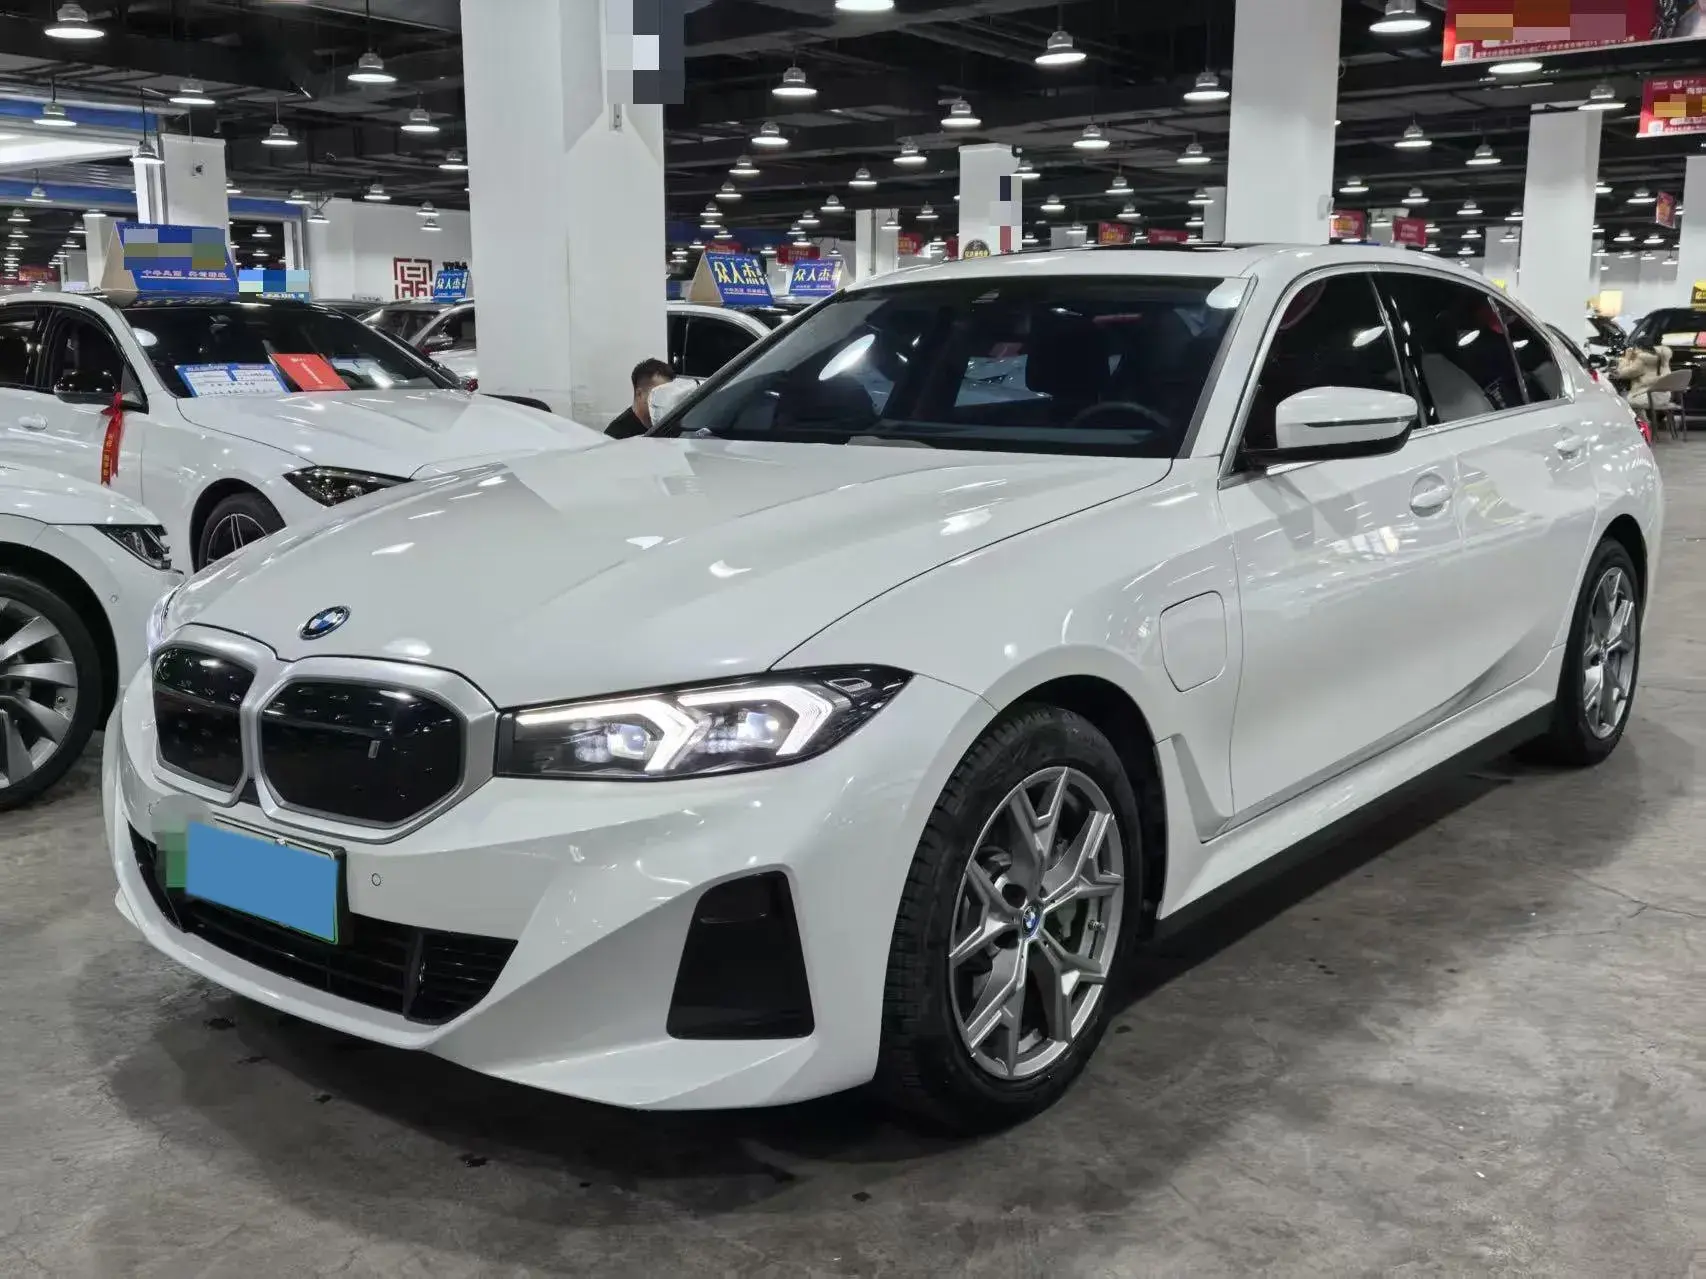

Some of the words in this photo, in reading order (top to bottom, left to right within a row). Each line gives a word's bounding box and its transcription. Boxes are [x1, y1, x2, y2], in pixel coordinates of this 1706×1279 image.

[714, 261, 757, 285] 众人杰
[794, 268, 829, 281] 众人杰
